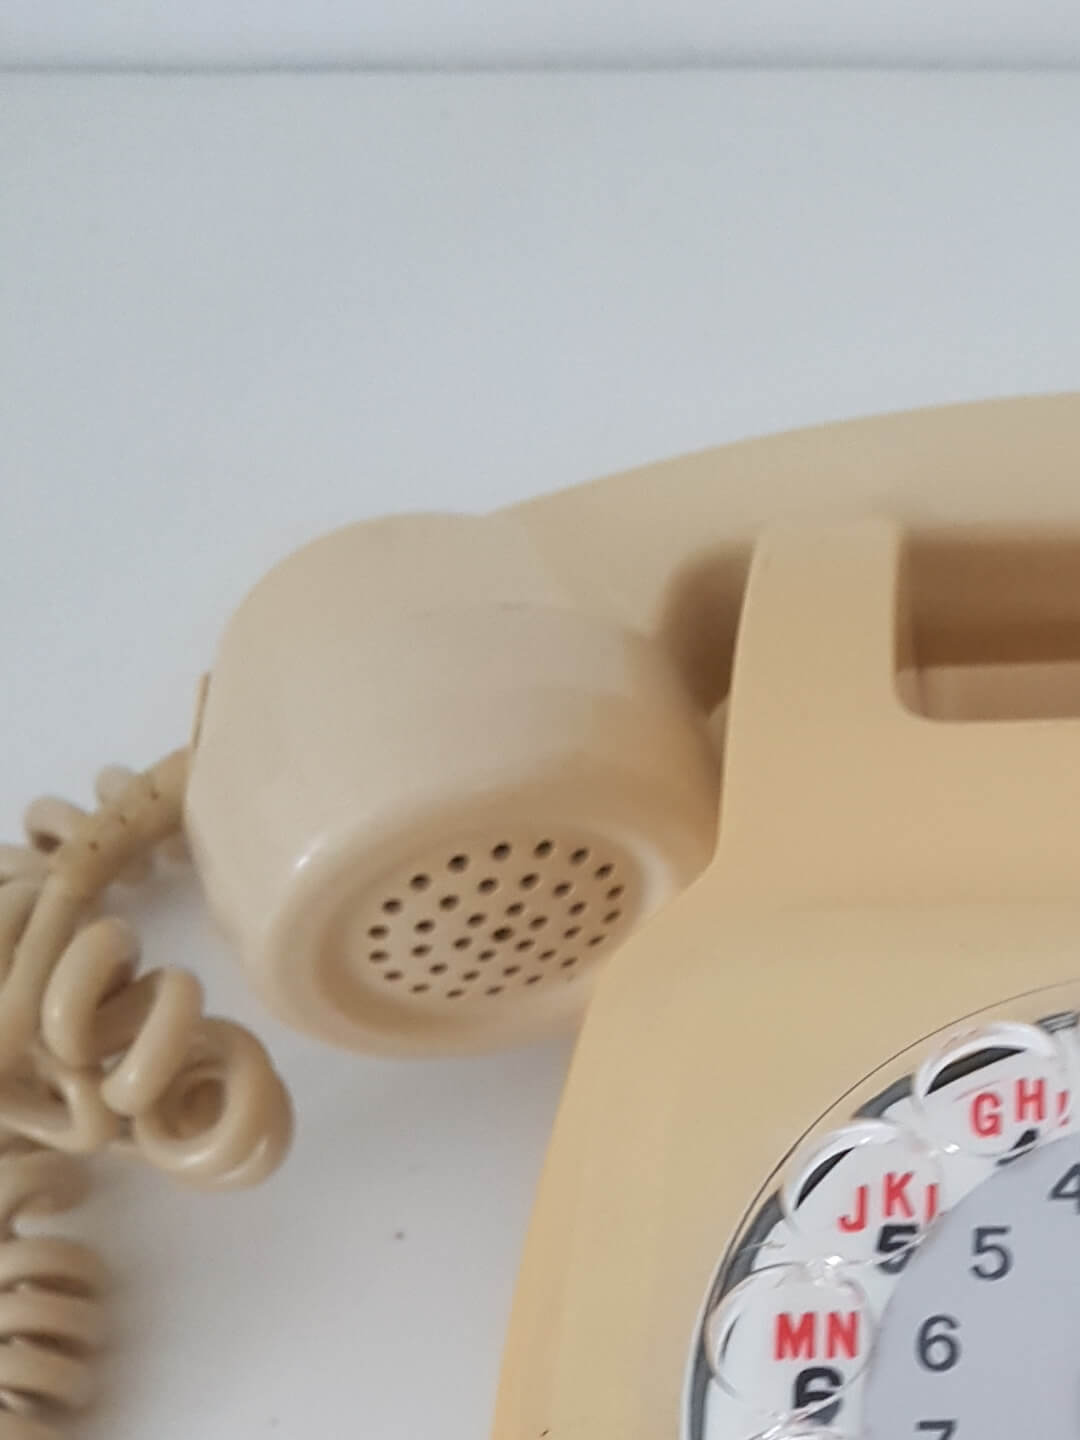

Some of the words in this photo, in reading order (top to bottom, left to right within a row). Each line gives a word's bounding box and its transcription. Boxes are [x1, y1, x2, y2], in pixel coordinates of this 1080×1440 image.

[970, 1227, 1013, 1280] 5
[774, 1312, 861, 1361] MN
[916, 1316, 959, 1373] 6
